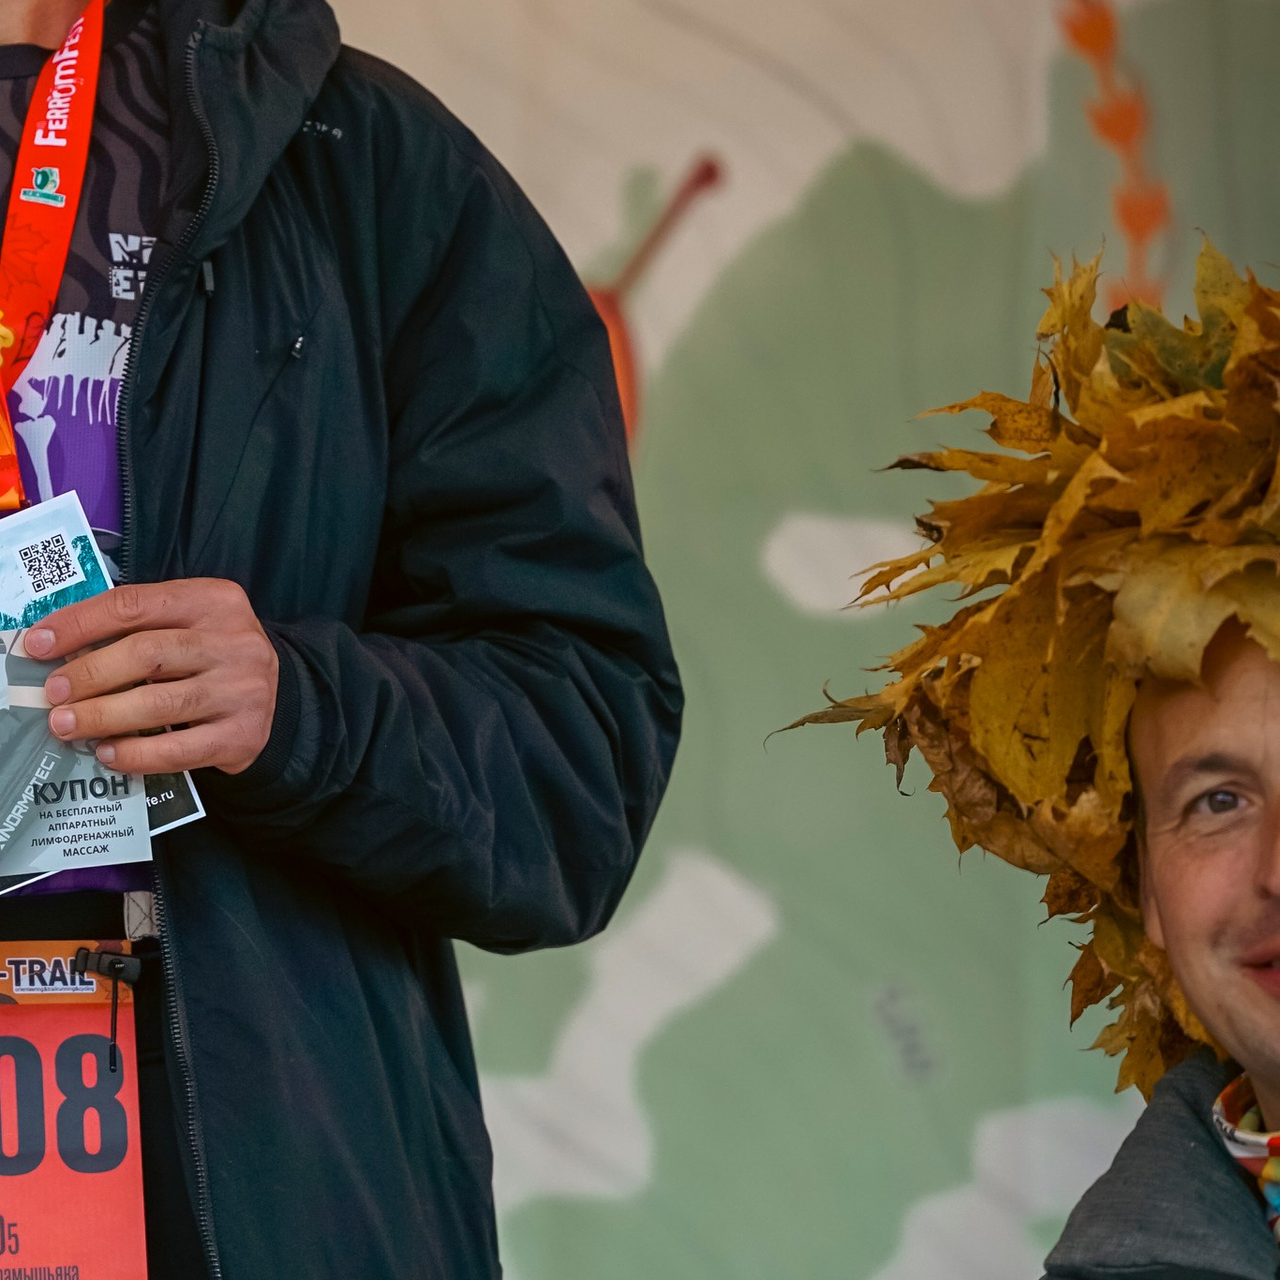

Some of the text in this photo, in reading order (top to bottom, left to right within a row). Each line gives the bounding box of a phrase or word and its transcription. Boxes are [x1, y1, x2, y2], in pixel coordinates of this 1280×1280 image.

[33, 774, 130, 806] КУПОН
[146, 790, 175, 807] fe.ru
[39, 802, 122, 819] НА БЕСПЛАТНЫЙ
[48, 816, 116, 832] АППАРАТНЫЙ
[31, 826, 135, 847] ЛИМФОДРЕНАЖНЫЙ
[63, 844, 109, 857] МАССАЖ
